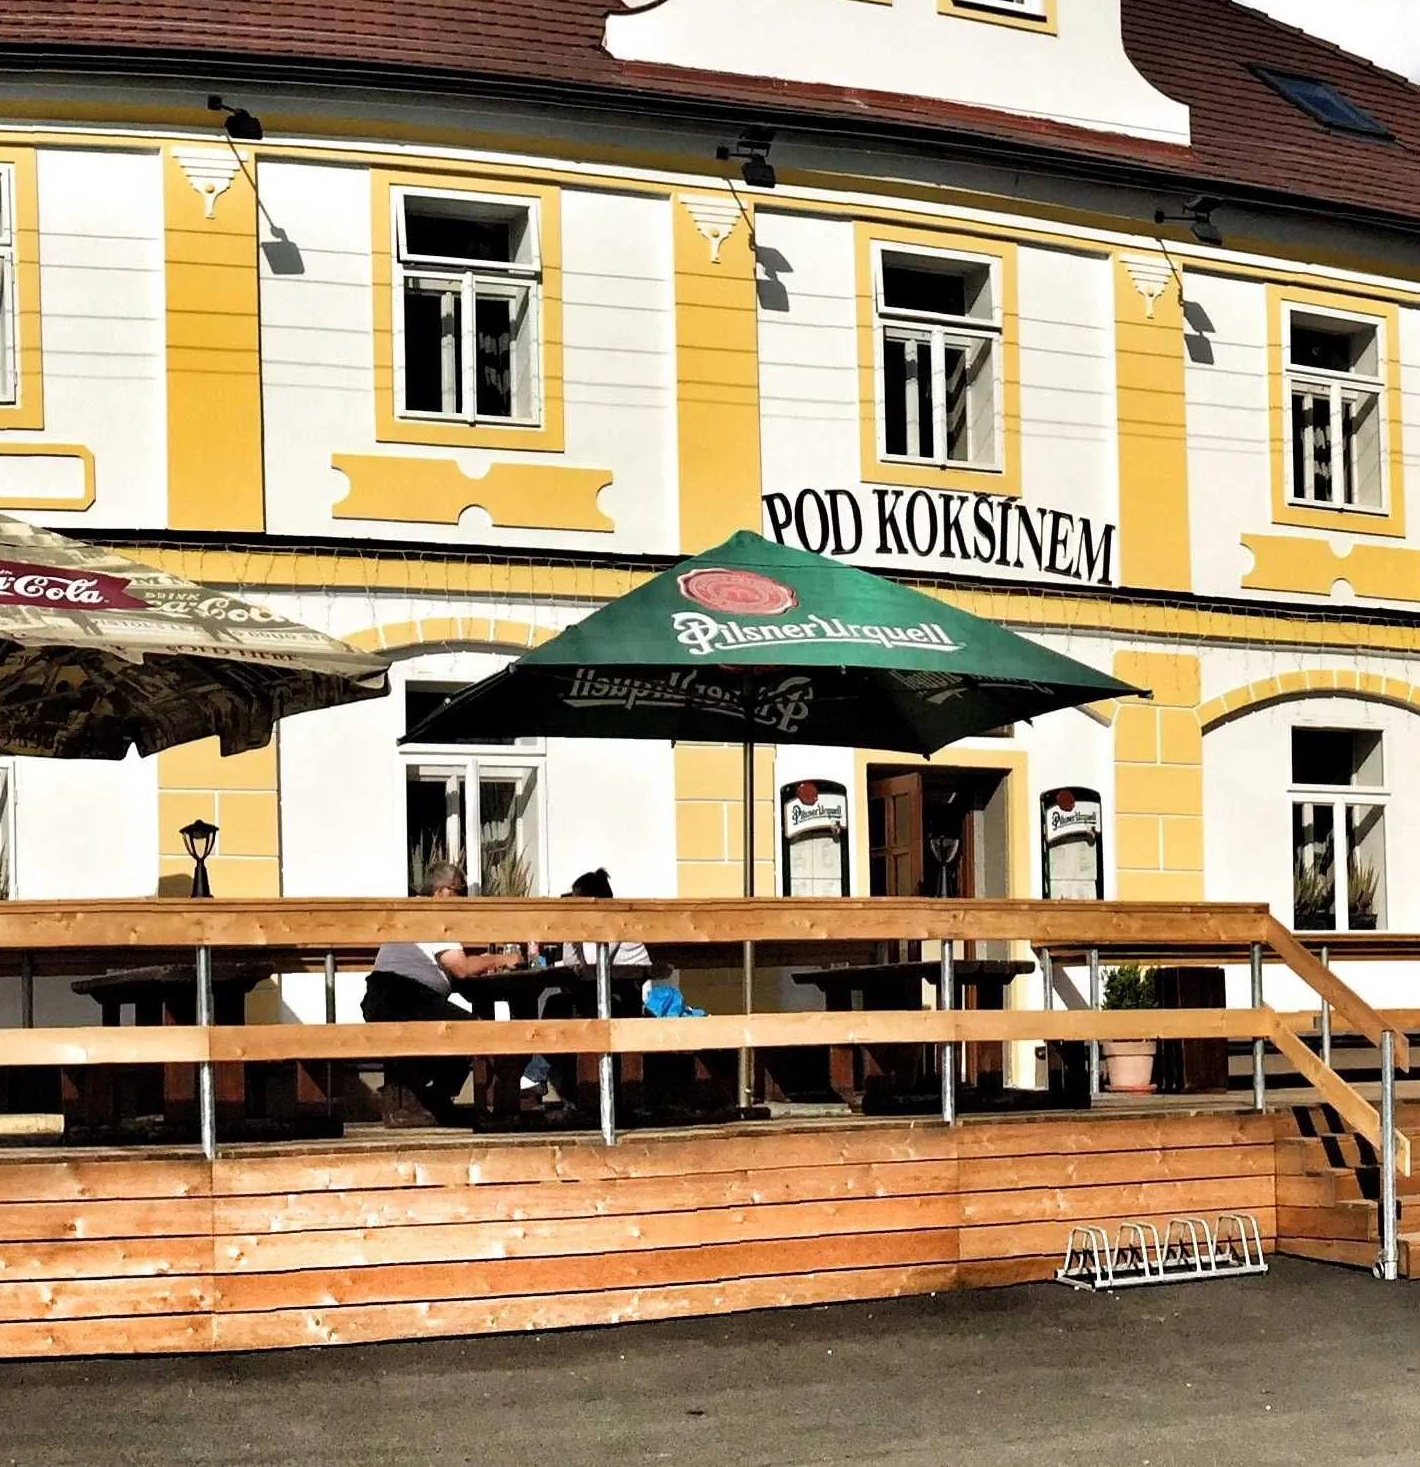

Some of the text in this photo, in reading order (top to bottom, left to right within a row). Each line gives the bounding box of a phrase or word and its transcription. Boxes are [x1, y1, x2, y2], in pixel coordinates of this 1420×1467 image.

[762, 488, 1116, 585] POD KOKŠÍNEM
[671, 611, 954, 655] Pilsner Urquell
